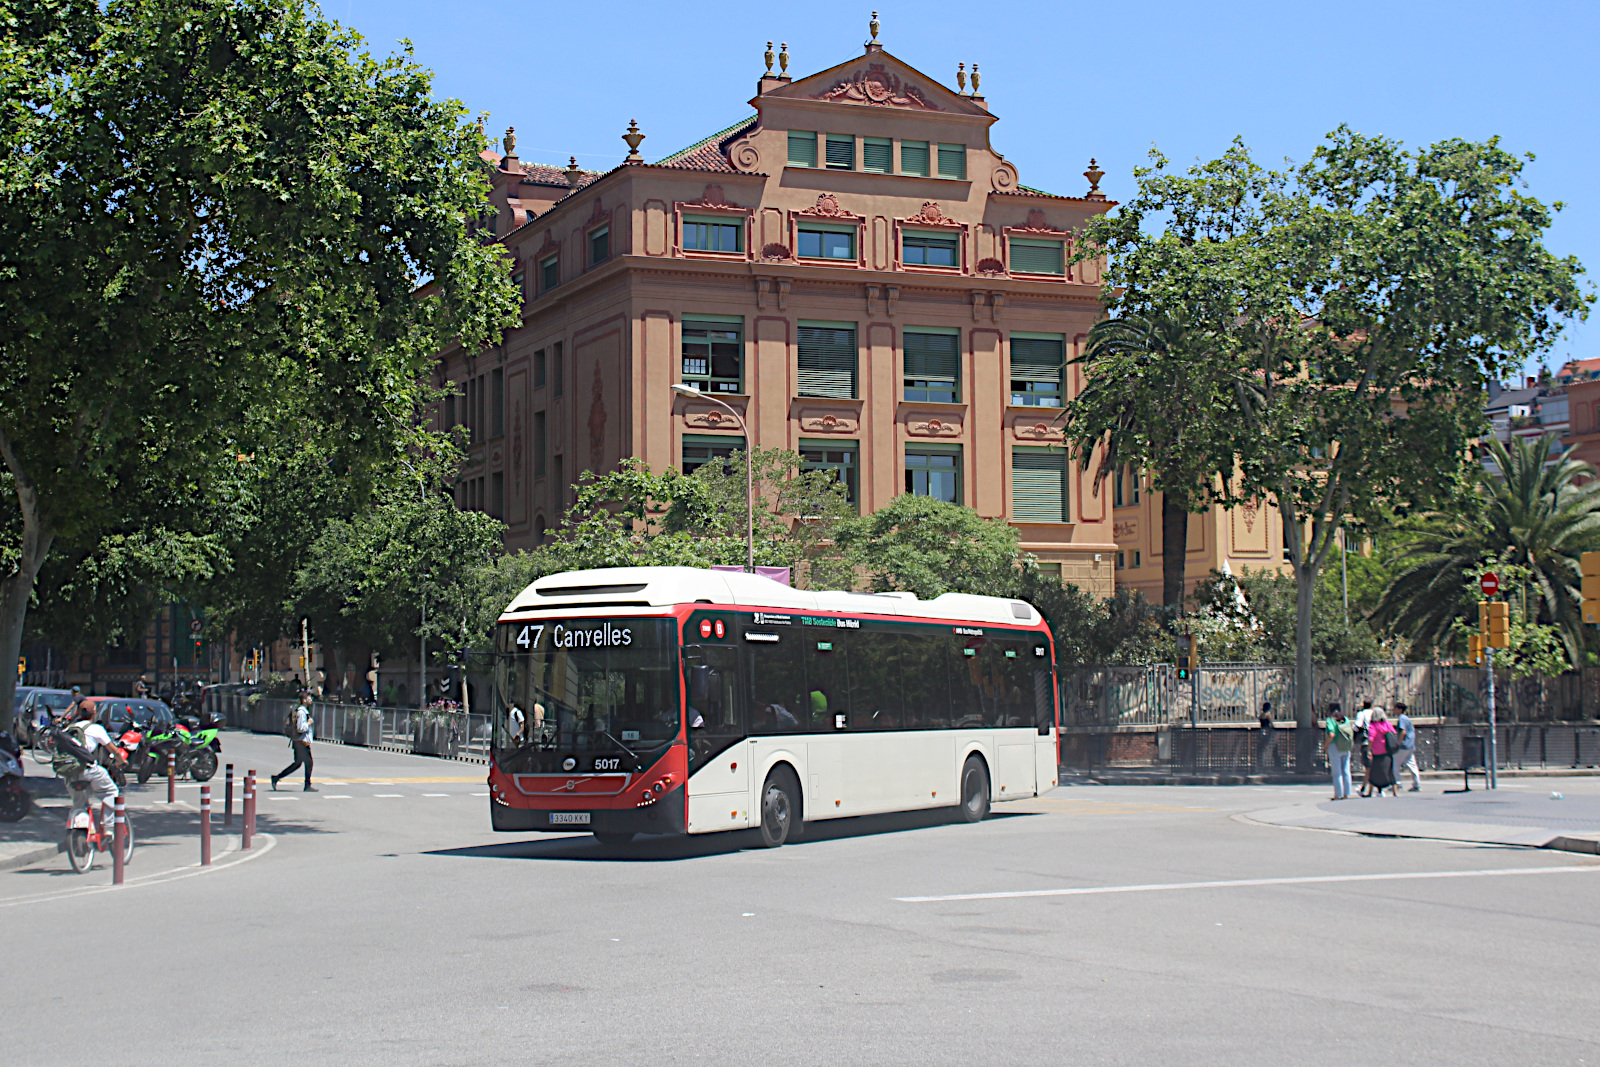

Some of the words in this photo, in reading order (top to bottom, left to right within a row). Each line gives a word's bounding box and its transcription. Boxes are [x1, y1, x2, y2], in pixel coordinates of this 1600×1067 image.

[716, 623, 723, 635] B
[516, 624, 544, 649] 47
[554, 622, 632, 648] Canyelles
[594, 758, 620, 770] 5017
[554, 813, 573, 823] 3340
[574, 813, 589, 823] KKY
